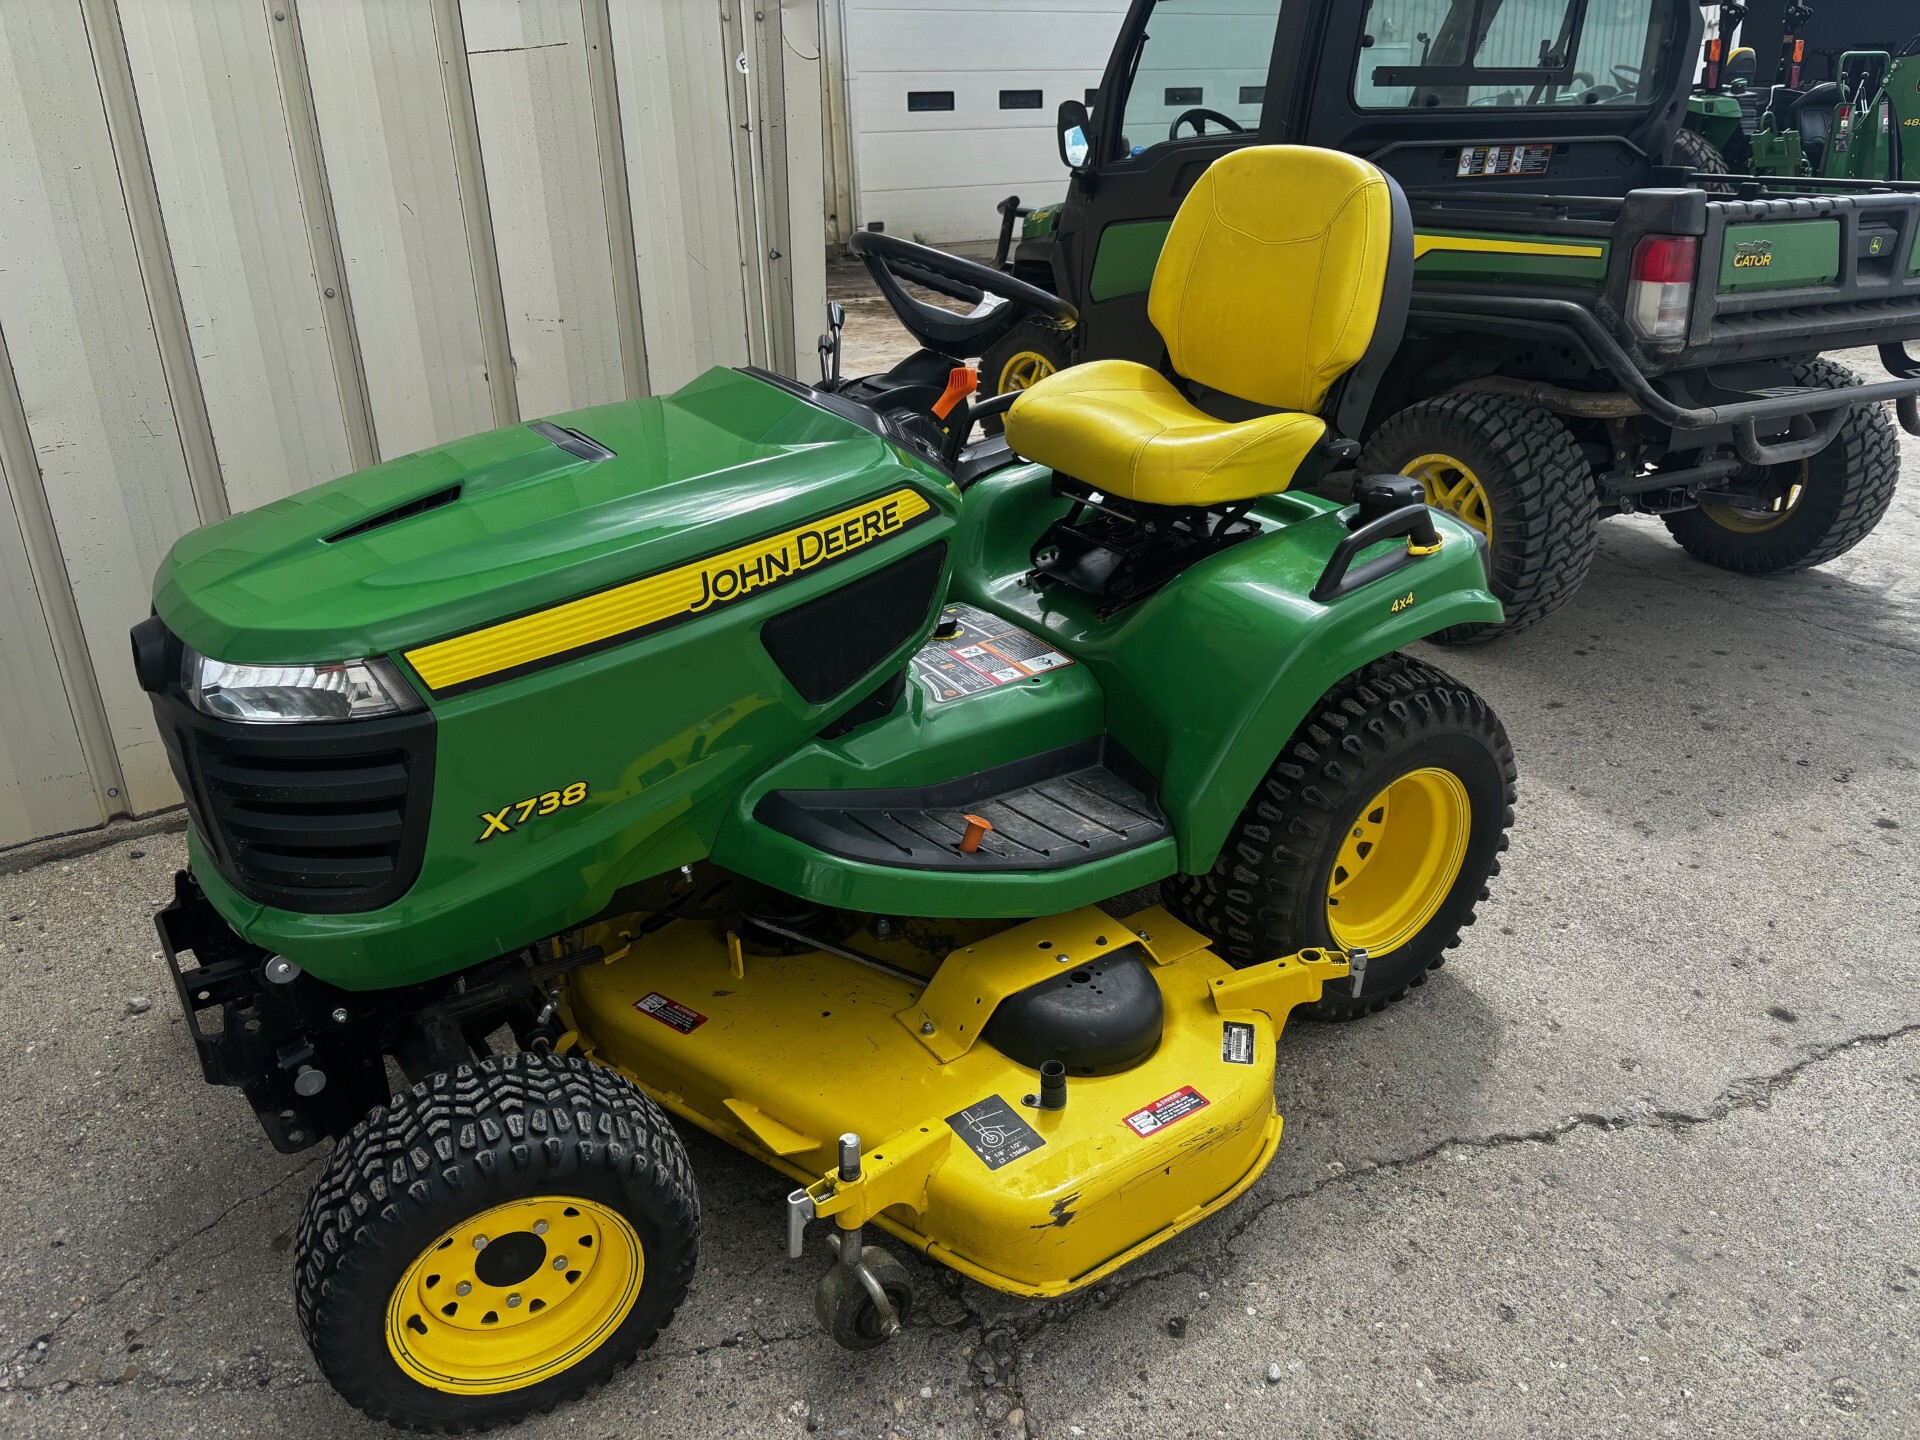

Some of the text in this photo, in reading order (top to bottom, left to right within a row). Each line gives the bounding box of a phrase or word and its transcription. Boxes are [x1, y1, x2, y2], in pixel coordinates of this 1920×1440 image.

[1904, 118, 1920, 127] 48
[1733, 253, 1772, 269] GATOR
[690, 500, 902, 612] JOHN DEERE
[1391, 591, 1413, 612] 4x4
[478, 782, 588, 842] X738
[1160, 1092, 1182, 1104] DANGER
